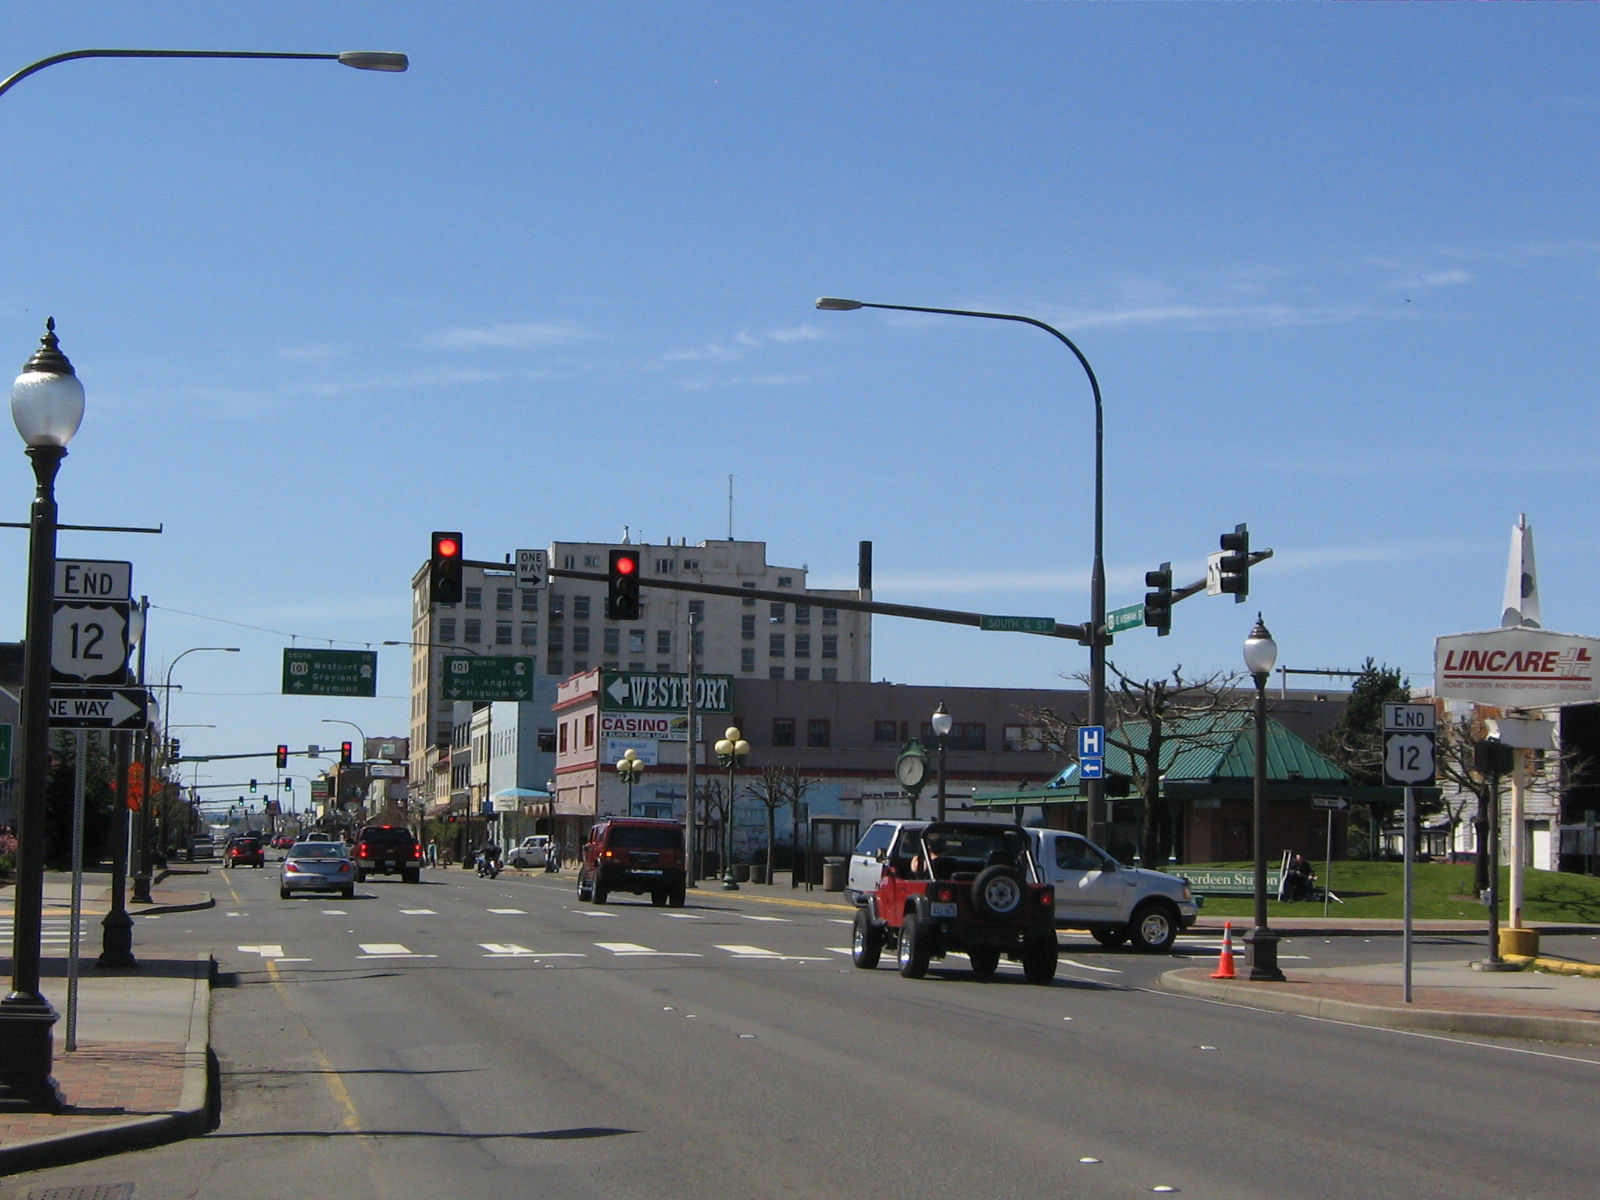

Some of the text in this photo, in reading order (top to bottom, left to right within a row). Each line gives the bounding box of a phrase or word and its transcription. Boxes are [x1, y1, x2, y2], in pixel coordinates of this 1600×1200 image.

[521, 552, 542, 562] ONE
[521, 563, 543, 572] WAY
[65, 565, 113, 595] END
[988, 617, 1018, 629] SOUTH
[1036, 620, 1047, 630] ST
[70, 623, 104, 660] 12
[292, 663, 307, 673] 101
[453, 663, 468, 671] 101
[1444, 650, 1560, 673] LINCARE
[312, 673, 358, 682] Grayland
[454, 678, 475, 686] Port
[312, 683, 358, 692] Raymond
[630, 676, 728, 709] WESTPORT
[49, 701, 109, 716] NE WAY
[1394, 707, 1425, 727] END
[601, 718, 669, 731] CASINO
[1084, 731, 1098, 753] H
[1399, 746, 1420, 770] 12
[1234, 874, 1278, 886] Stan
